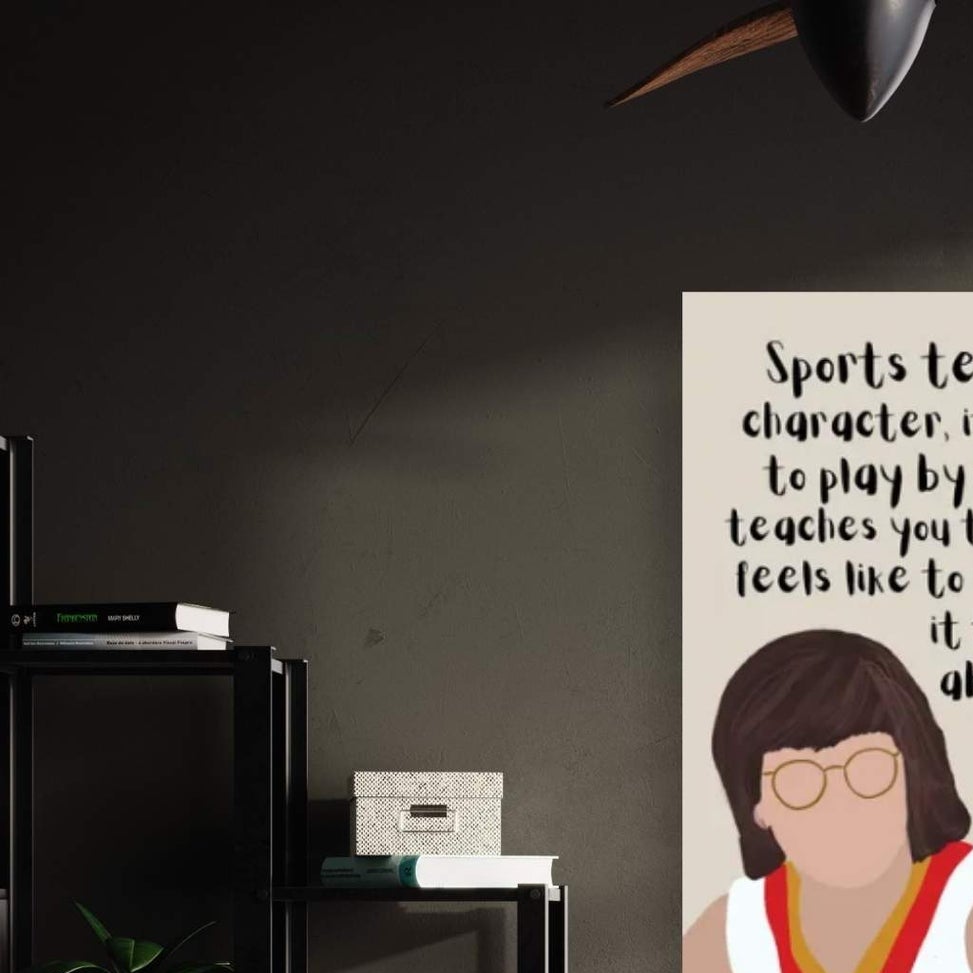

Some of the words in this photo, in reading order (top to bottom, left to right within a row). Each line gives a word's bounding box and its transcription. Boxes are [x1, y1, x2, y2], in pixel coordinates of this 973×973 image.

[766, 340, 907, 399] Sports
[742, 401, 949, 443] character,
[765, 454, 806, 496] to
[820, 457, 902, 509] play
[917, 453, 965, 509] by
[726, 507, 877, 547] teaches
[890, 518, 950, 558] you
[736, 560, 831, 597] feels
[846, 560, 909, 596] like
[923, 558, 963, 599] to
[931, 610, 960, 651] it
